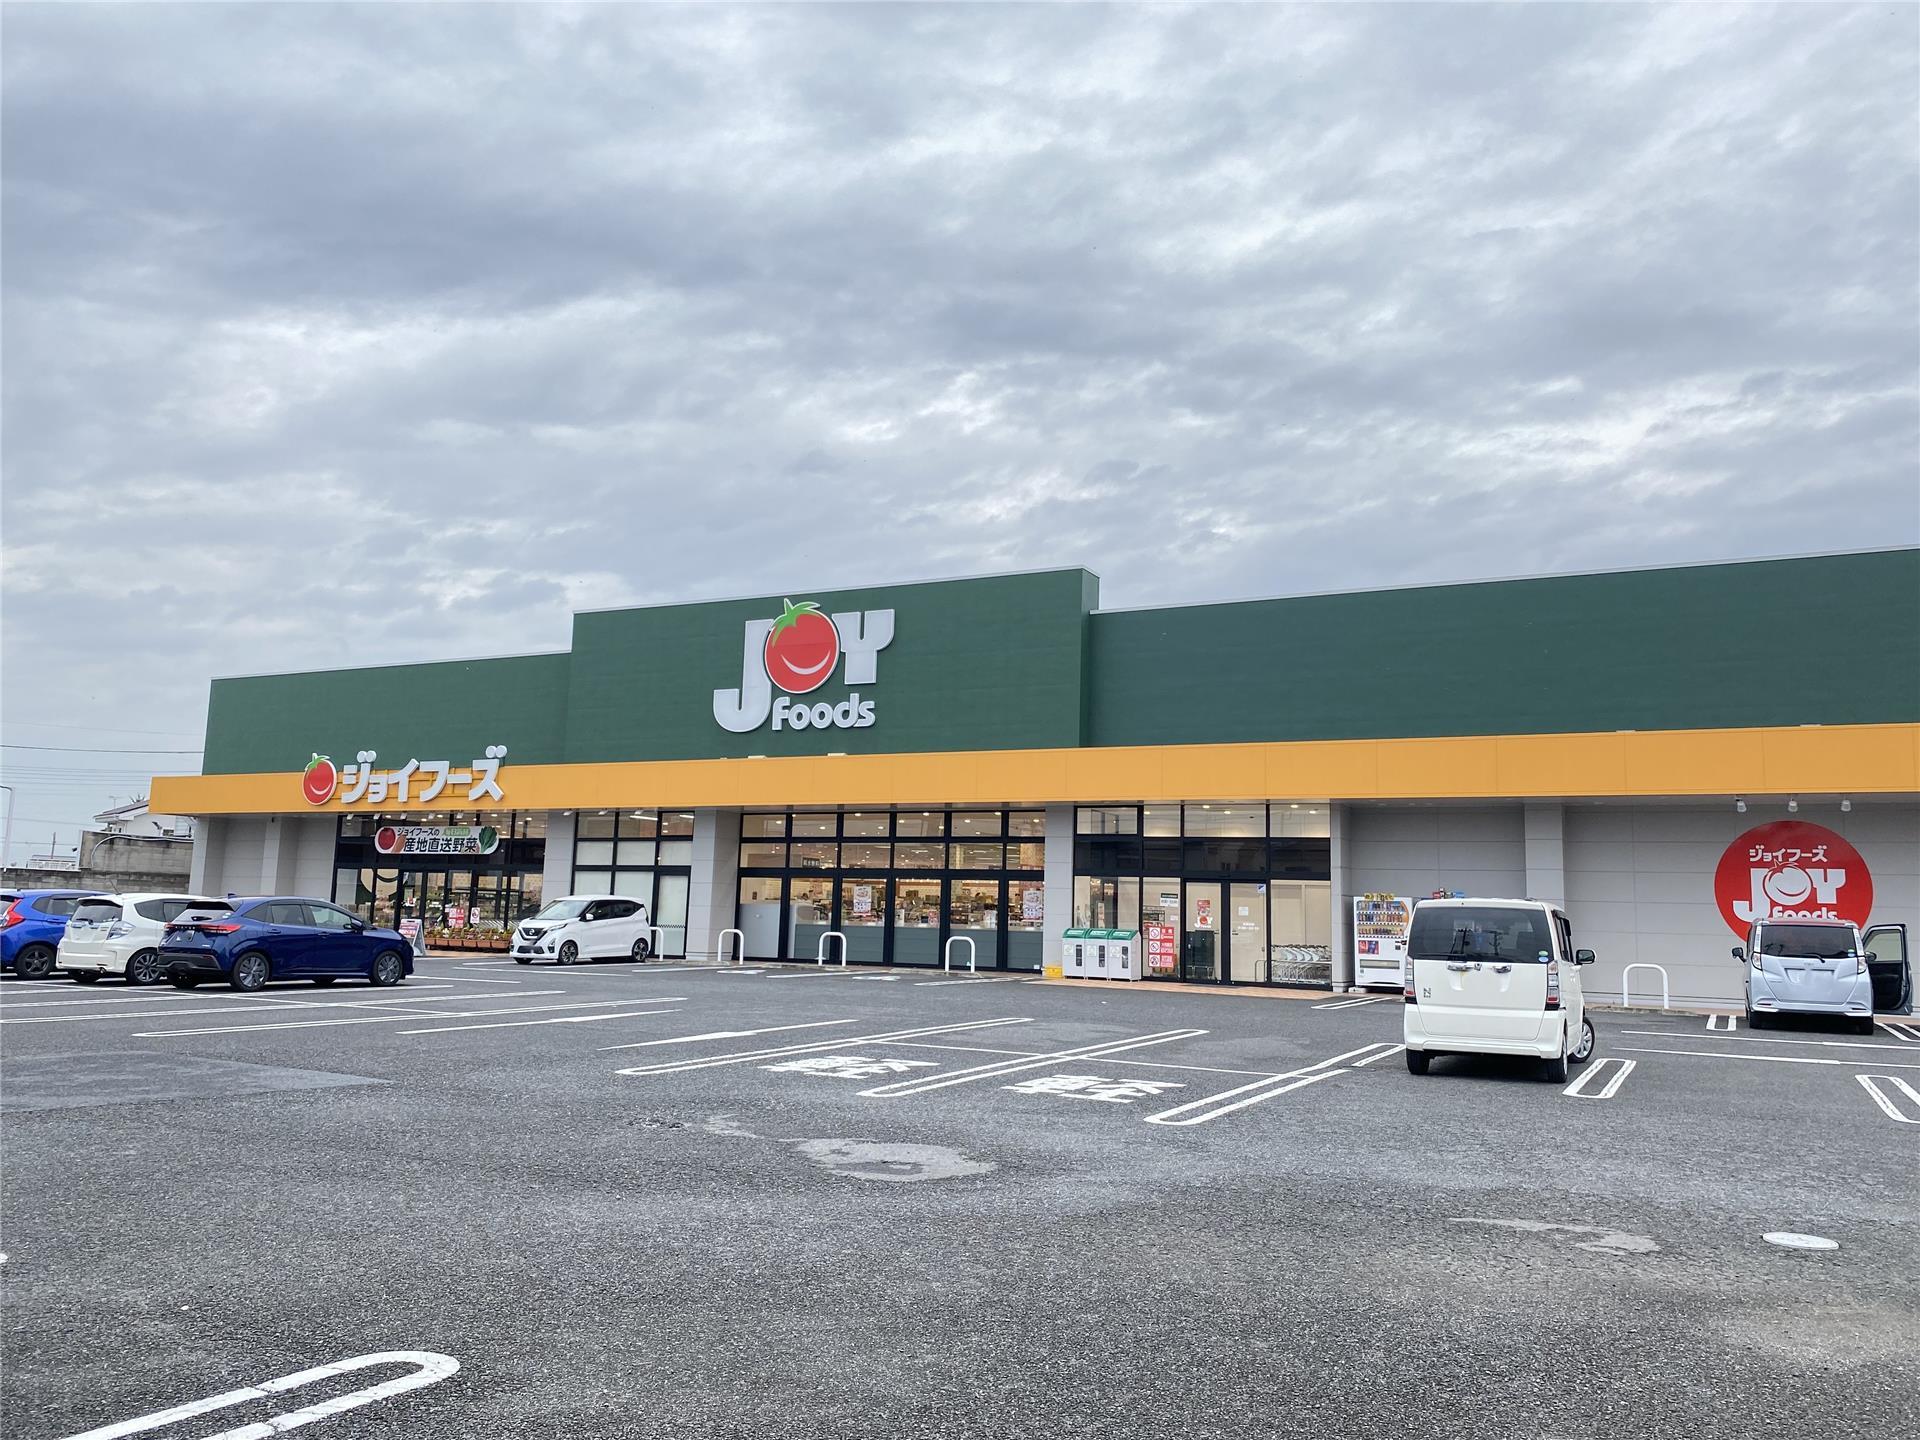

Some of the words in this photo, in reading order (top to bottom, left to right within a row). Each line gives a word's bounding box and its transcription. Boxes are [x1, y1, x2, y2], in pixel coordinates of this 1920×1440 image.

[713, 598, 895, 733] JOY
[771, 693, 876, 731] foods
[341, 745, 508, 804] ジョイフーズ
[397, 827, 440, 836] ジョイフーズの
[403, 837, 478, 853] 産地直送野菜
[1749, 844, 1829, 863] ジョイフーズ
[1732, 860, 1847, 923] JOY
[1000, 1074, 1187, 1103] 軽
